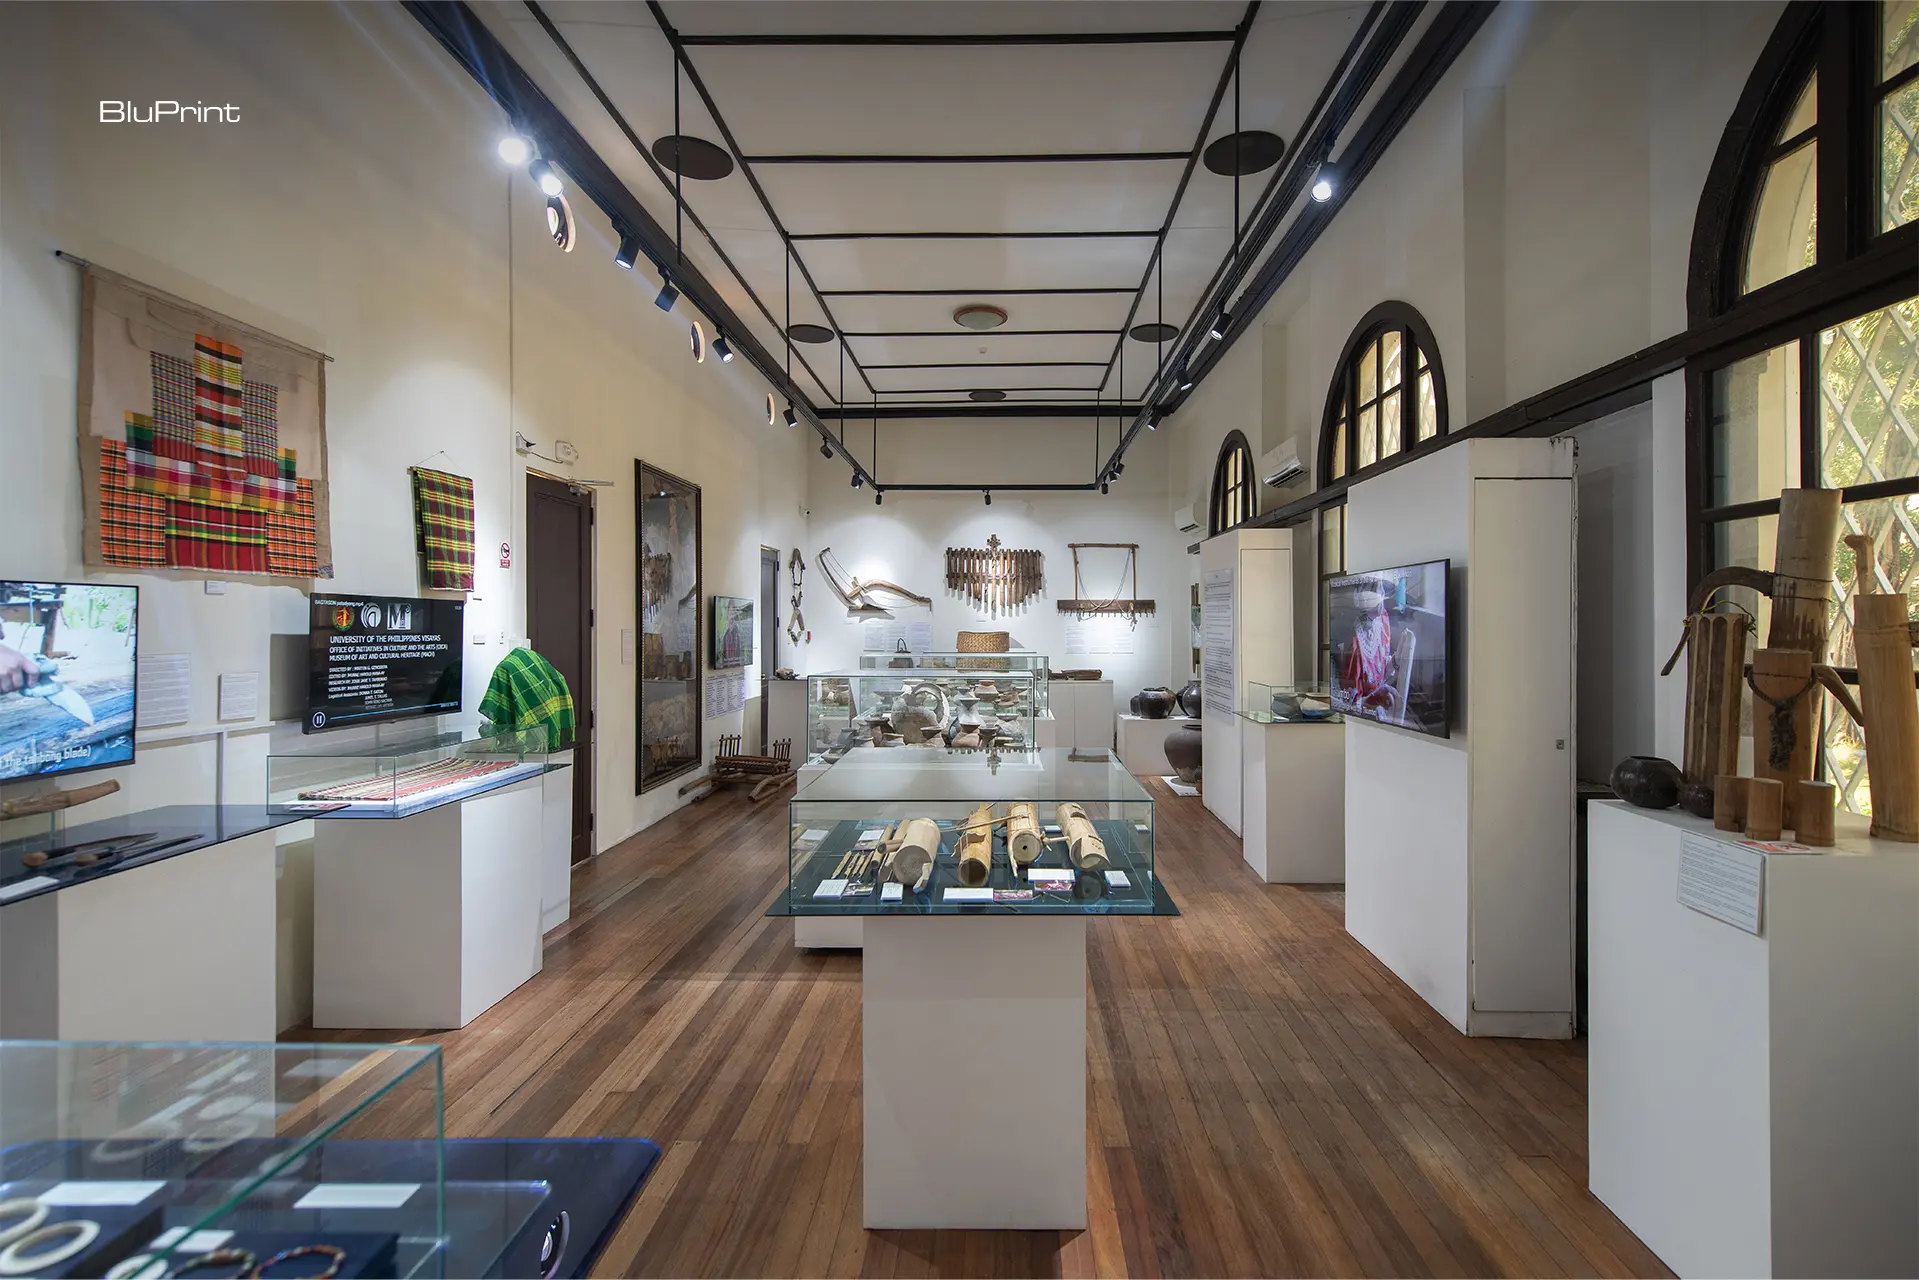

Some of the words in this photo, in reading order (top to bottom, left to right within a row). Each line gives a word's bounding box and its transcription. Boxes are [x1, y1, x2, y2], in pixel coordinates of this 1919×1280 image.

[366, 635, 375, 643] OF
[376, 635, 387, 643] THE
[63, 744, 92, 759] blade)
